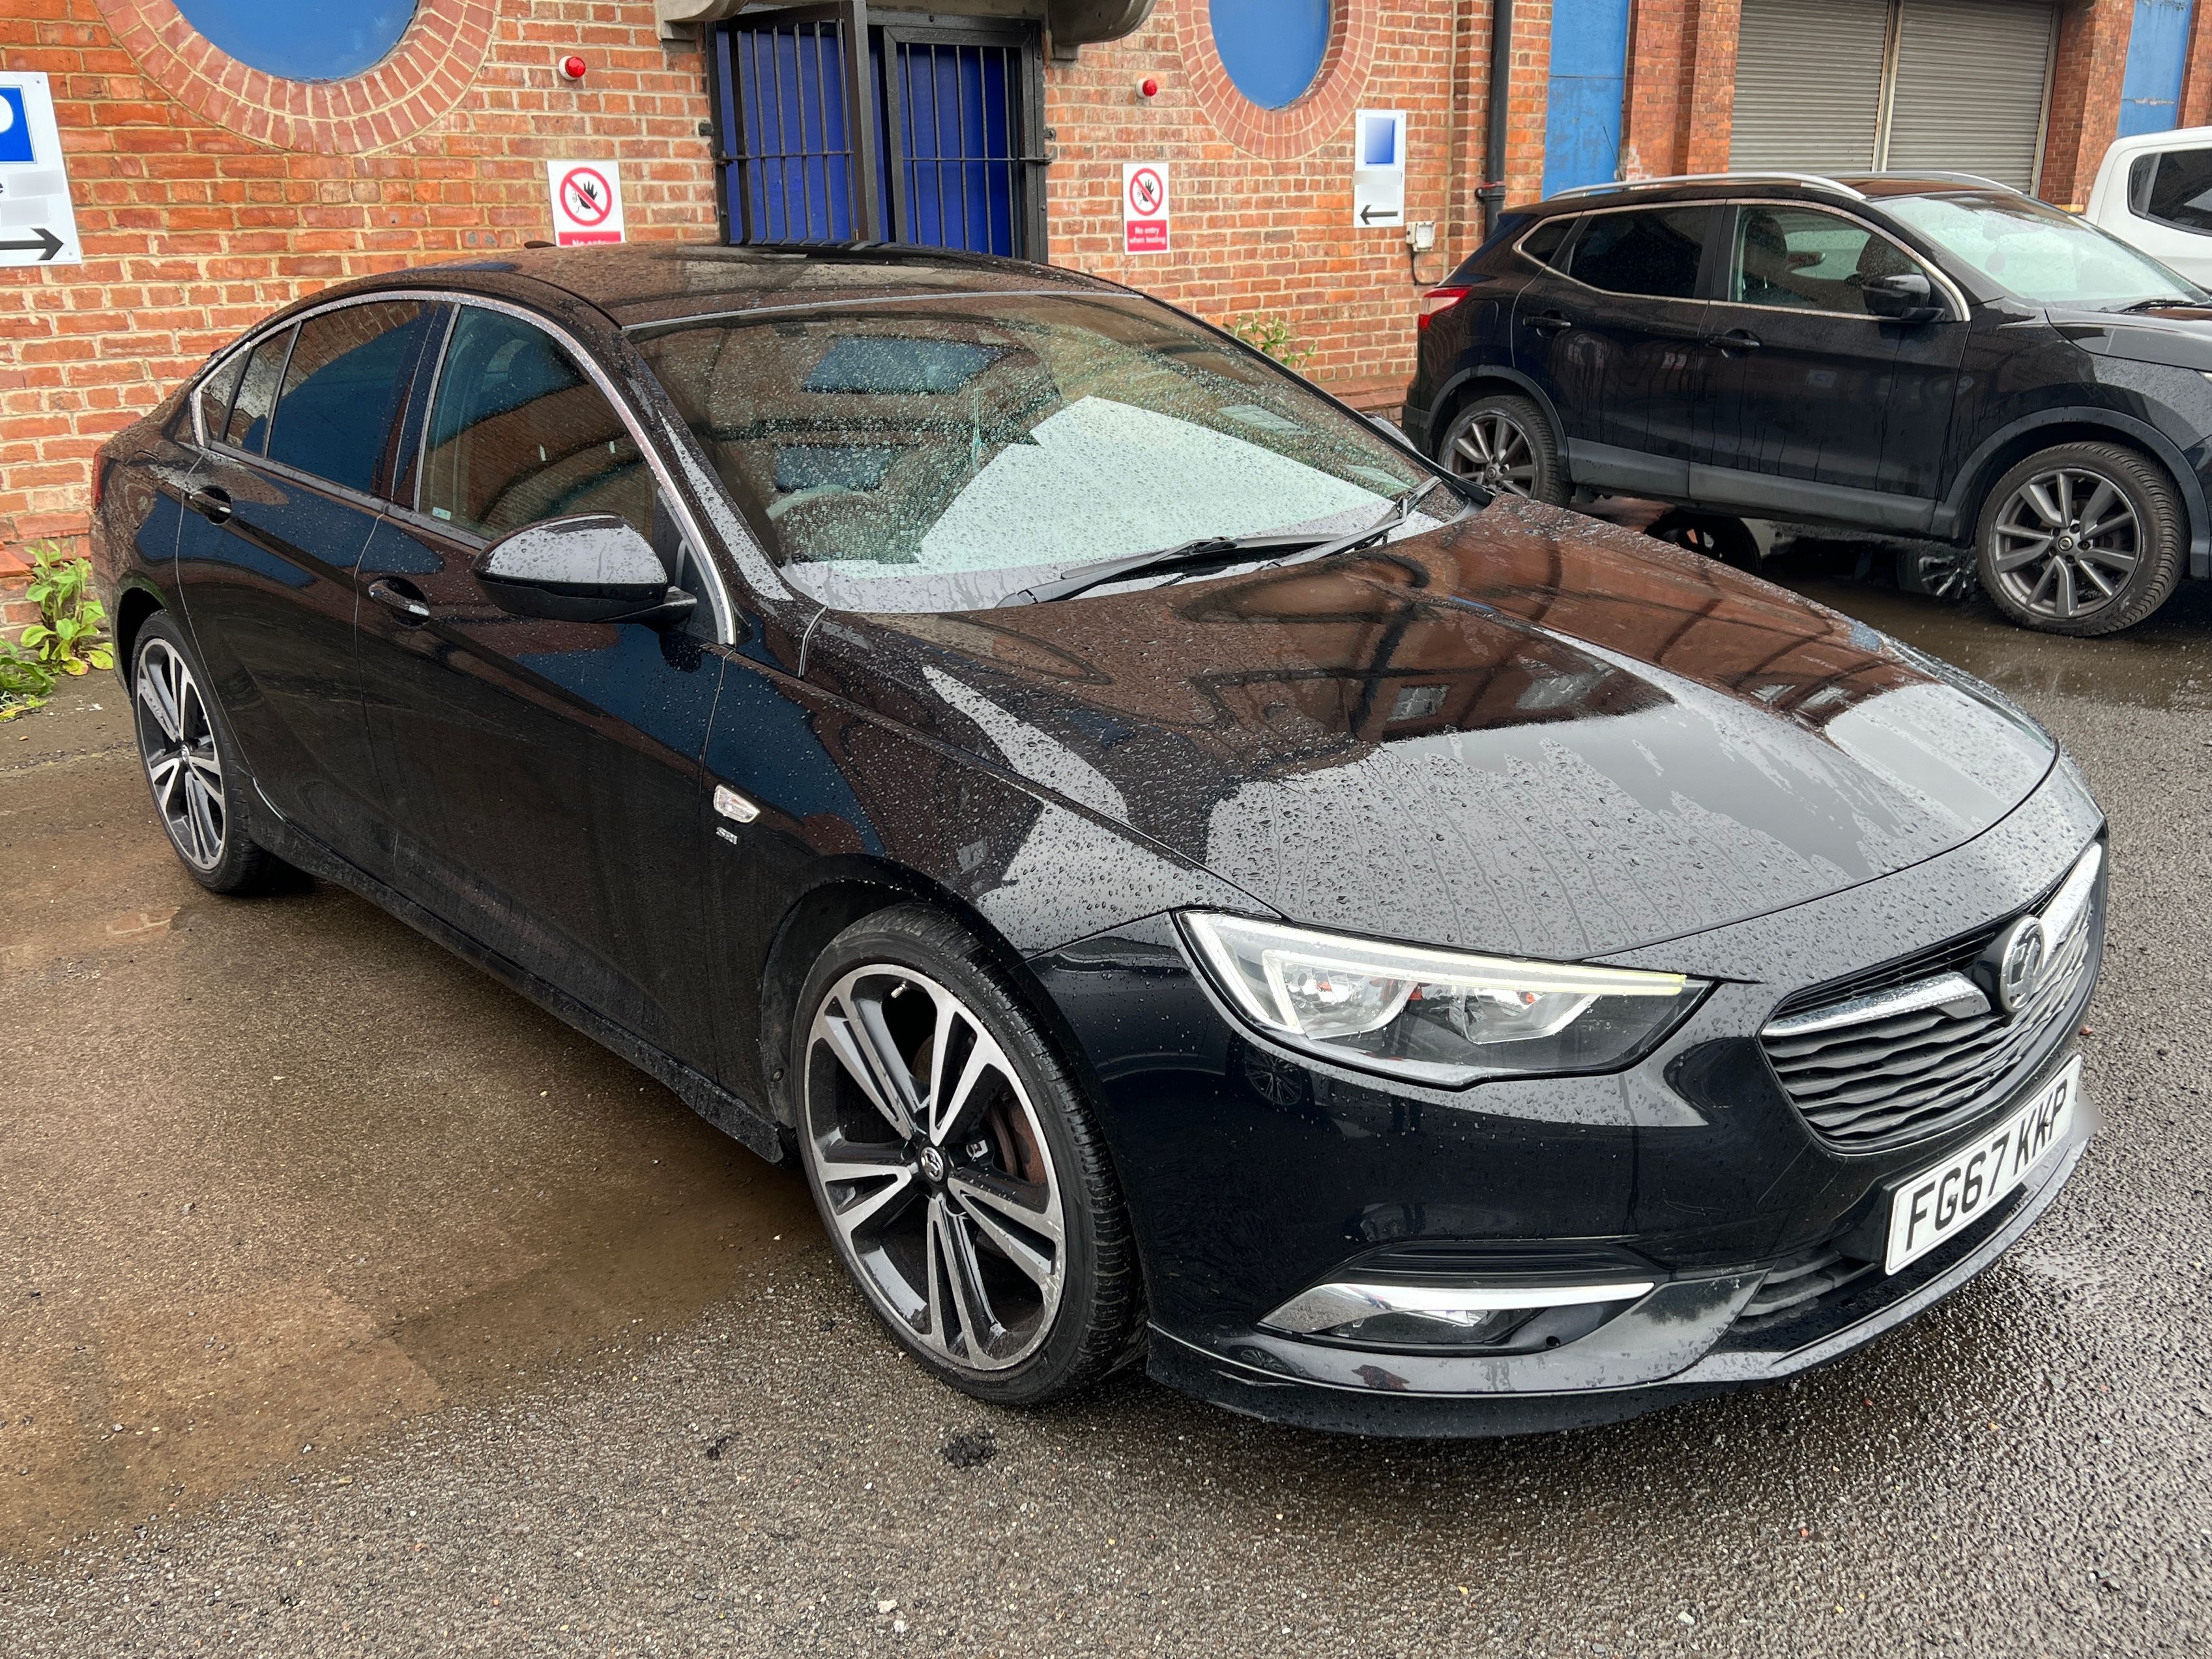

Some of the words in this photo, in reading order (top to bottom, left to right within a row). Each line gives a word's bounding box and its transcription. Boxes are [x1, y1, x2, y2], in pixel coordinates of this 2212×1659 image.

[1144, 227, 1160, 237] entry
[1906, 1131, 2011, 1252] FG67
[2013, 1078, 2067, 1177] KKP
